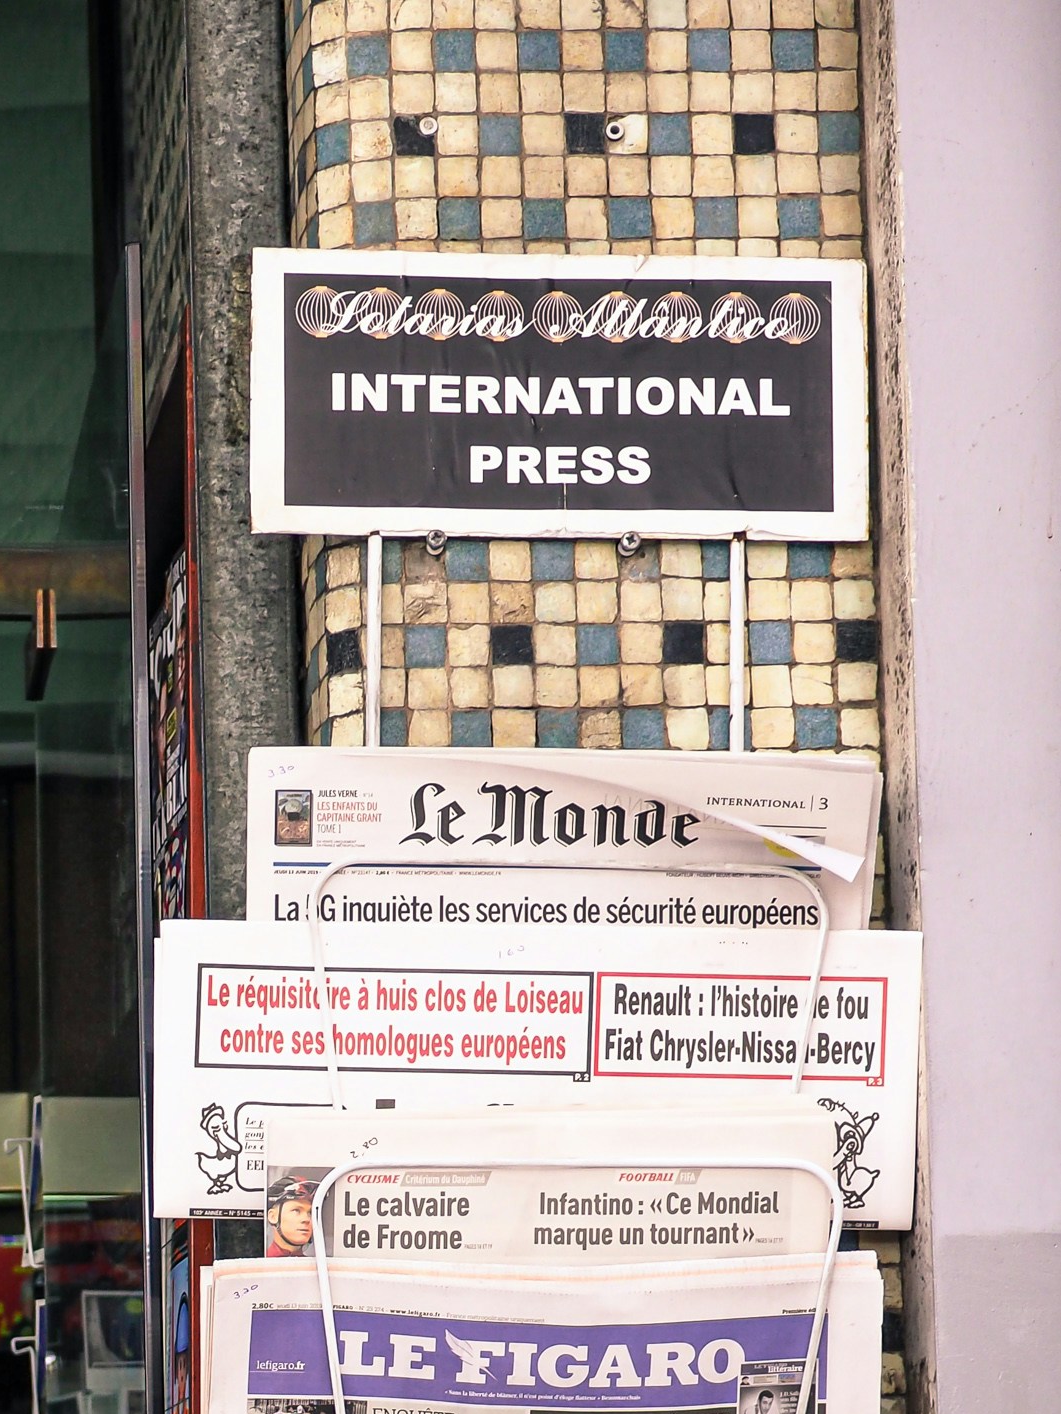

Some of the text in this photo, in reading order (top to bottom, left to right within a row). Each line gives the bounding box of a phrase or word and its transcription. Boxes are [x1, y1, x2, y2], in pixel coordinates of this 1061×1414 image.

[331, 372, 791, 417] INTERNATIONAL
[469, 445, 651, 485] PRESS
[317, 801, 365, 811] LES ENFANTS
[318, 790, 336, 798] JULES
[338, 790, 358, 798] VERNE
[706, 796, 806, 809] INTERNATIONAL
[317, 812, 382, 823] CAPITAINE GRANT
[398, 781, 701, 848] Le Monde
[317, 824, 337, 834] TOME
[343, 895, 818, 928] inquiète les services de sécurité européens
[207, 975, 229, 1007] Le
[358, 979, 368, 1009] à
[376, 980, 417, 1011] huis
[425, 981, 466, 1012] clos
[474, 982, 497, 1013] de
[504, 982, 583, 1014] Loiseau
[614, 983, 691, 1017] Renault
[836, 987, 868, 1019] fou
[221, 1024, 566, 1065] contre ses homologues européens
[605, 1028, 875, 1071] Fiat Chrysler-Nissa-Bercy
[347, 1173, 486, 1185] CYCLISME Critérium Dauphiné
[619, 1172, 696, 1182] FOOTBALL FIFA
[344, 1191, 469, 1217] Le calvaire
[540, 1192, 779, 1215] Infantino Ce Mondial
[343, 1224, 462, 1249] de Froome
[534, 1222, 739, 1250] marque tournant
[256, 1360, 305, 1371] lefigaro.fr
[340, 1330, 746, 1388] LE FIGARO
